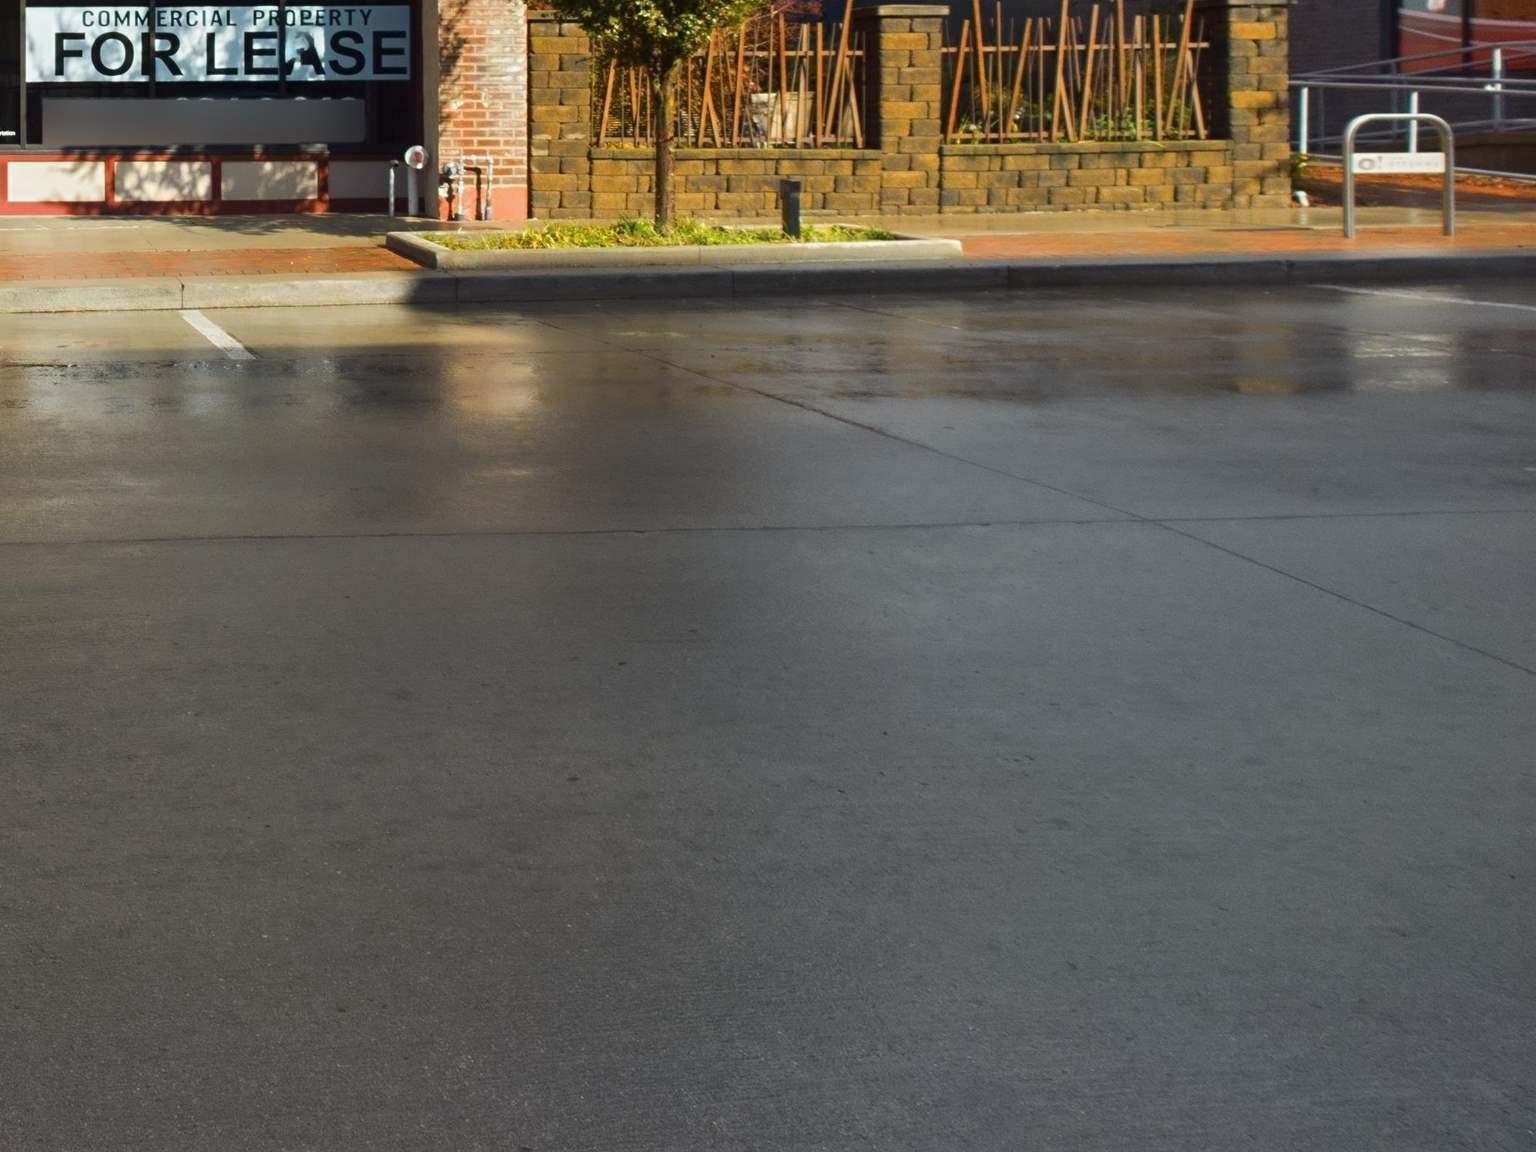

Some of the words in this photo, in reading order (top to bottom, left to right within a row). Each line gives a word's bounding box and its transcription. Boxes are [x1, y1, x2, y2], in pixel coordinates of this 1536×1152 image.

[82, 10, 237, 27] COMMERCIAL
[253, 9, 373, 26] PROPERTY
[54, 31, 184, 76] FOR
[206, 30, 408, 76] LEASE
